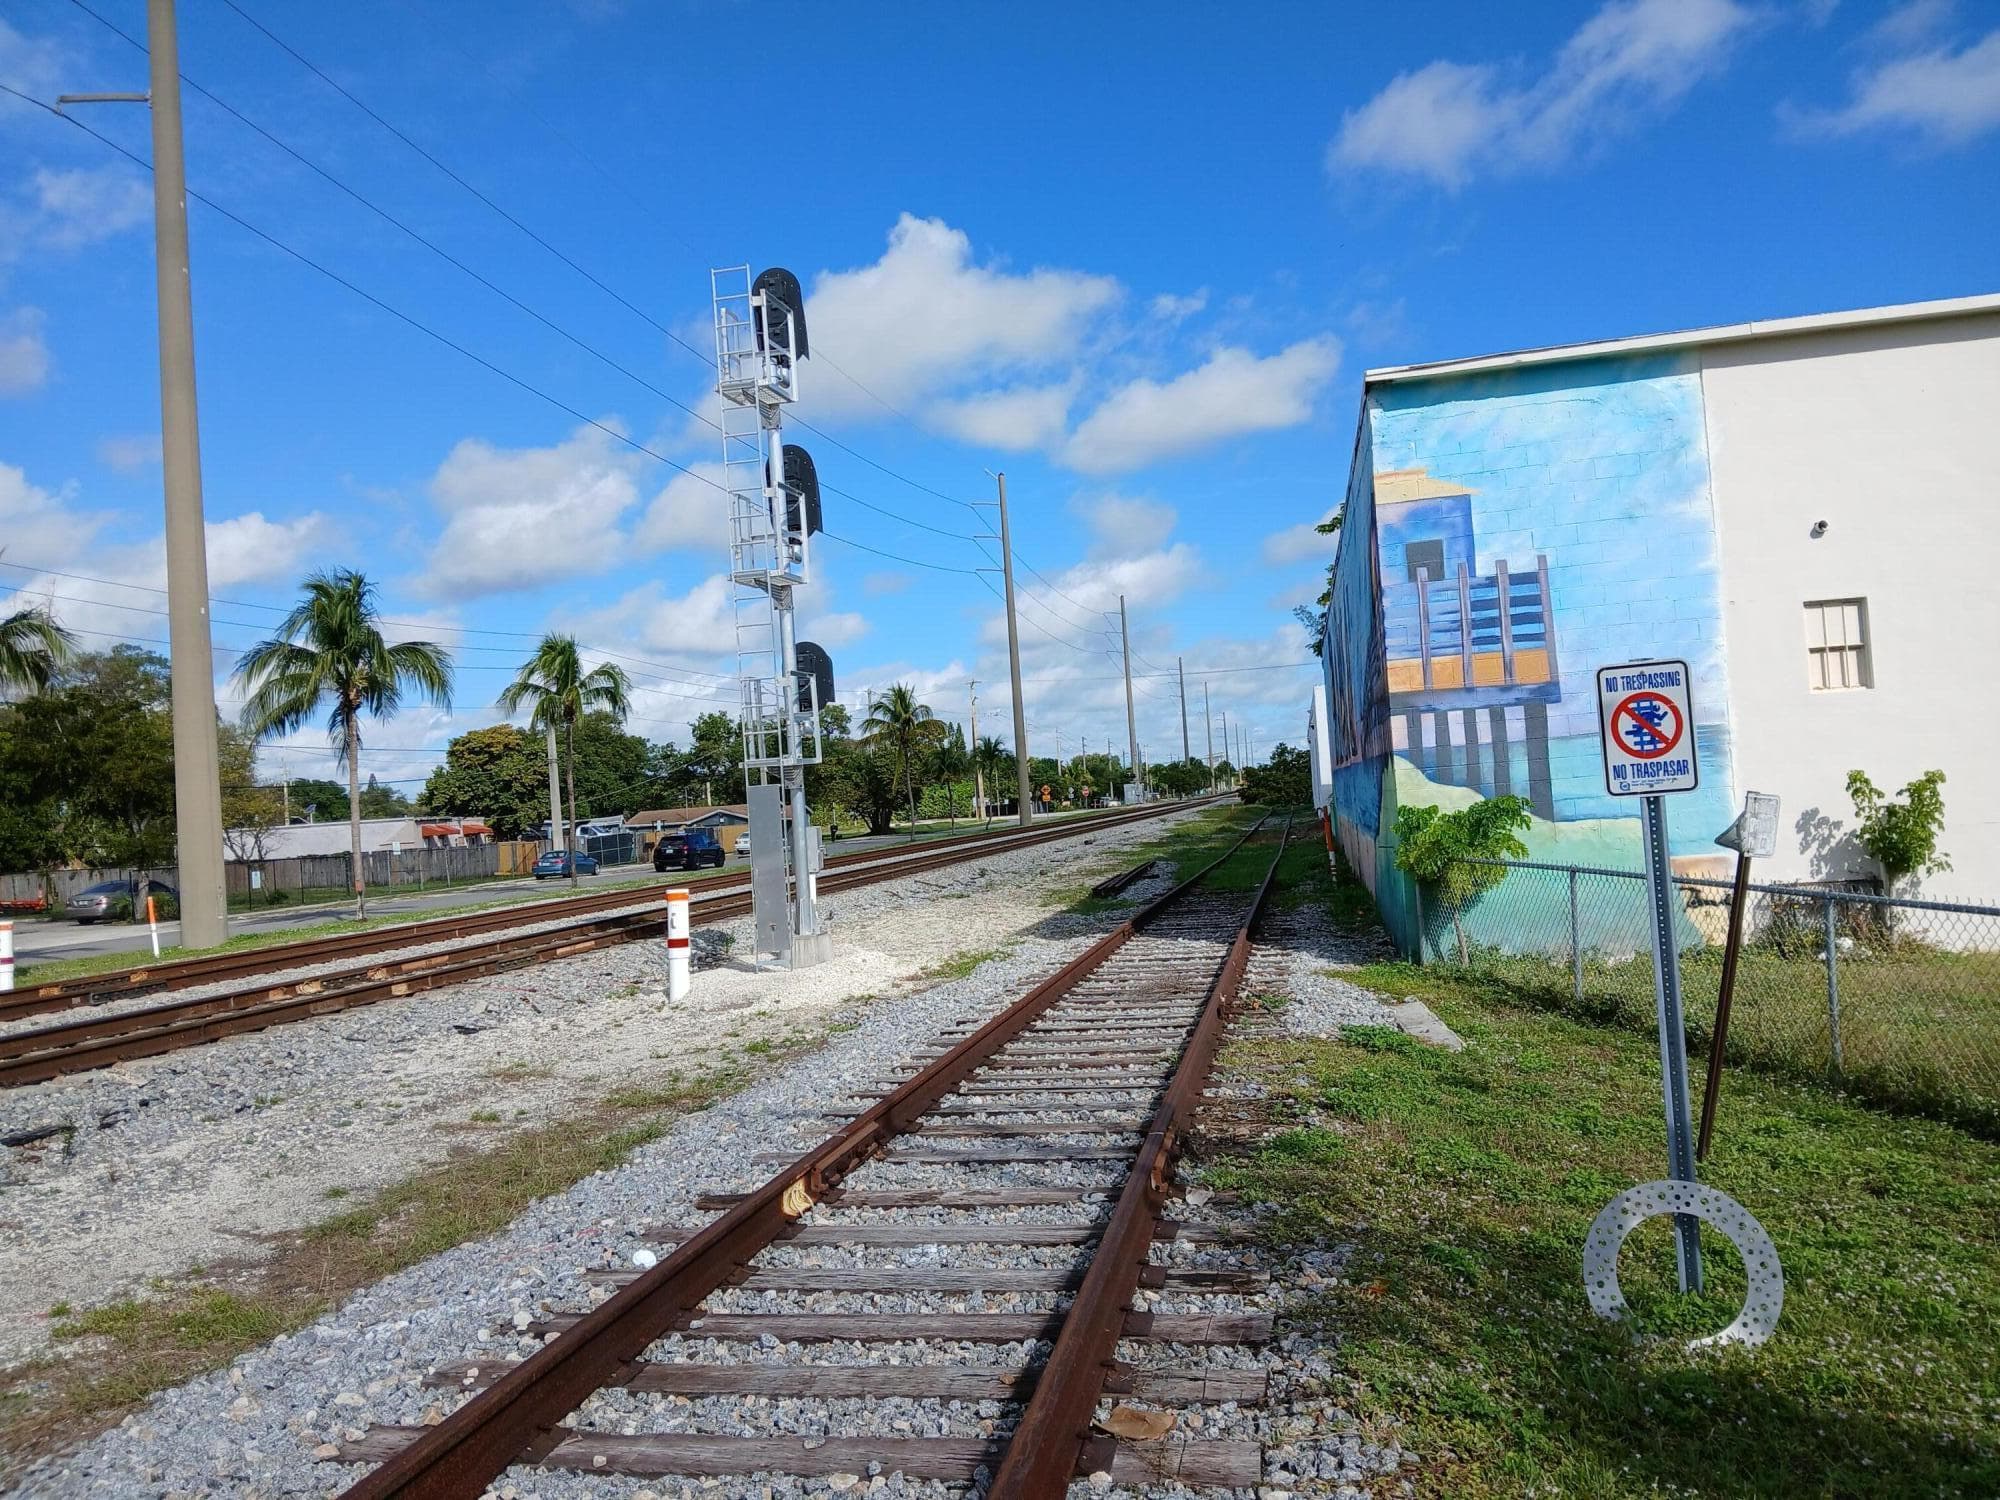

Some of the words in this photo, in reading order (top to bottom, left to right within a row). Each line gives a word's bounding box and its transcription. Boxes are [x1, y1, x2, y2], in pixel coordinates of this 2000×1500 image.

[1605, 677, 1618, 693] NO
[1620, 671, 1680, 691] TRESPASSING
[1613, 765, 1627, 780] NO
[1630, 760, 1689, 778] TRASPASAR
